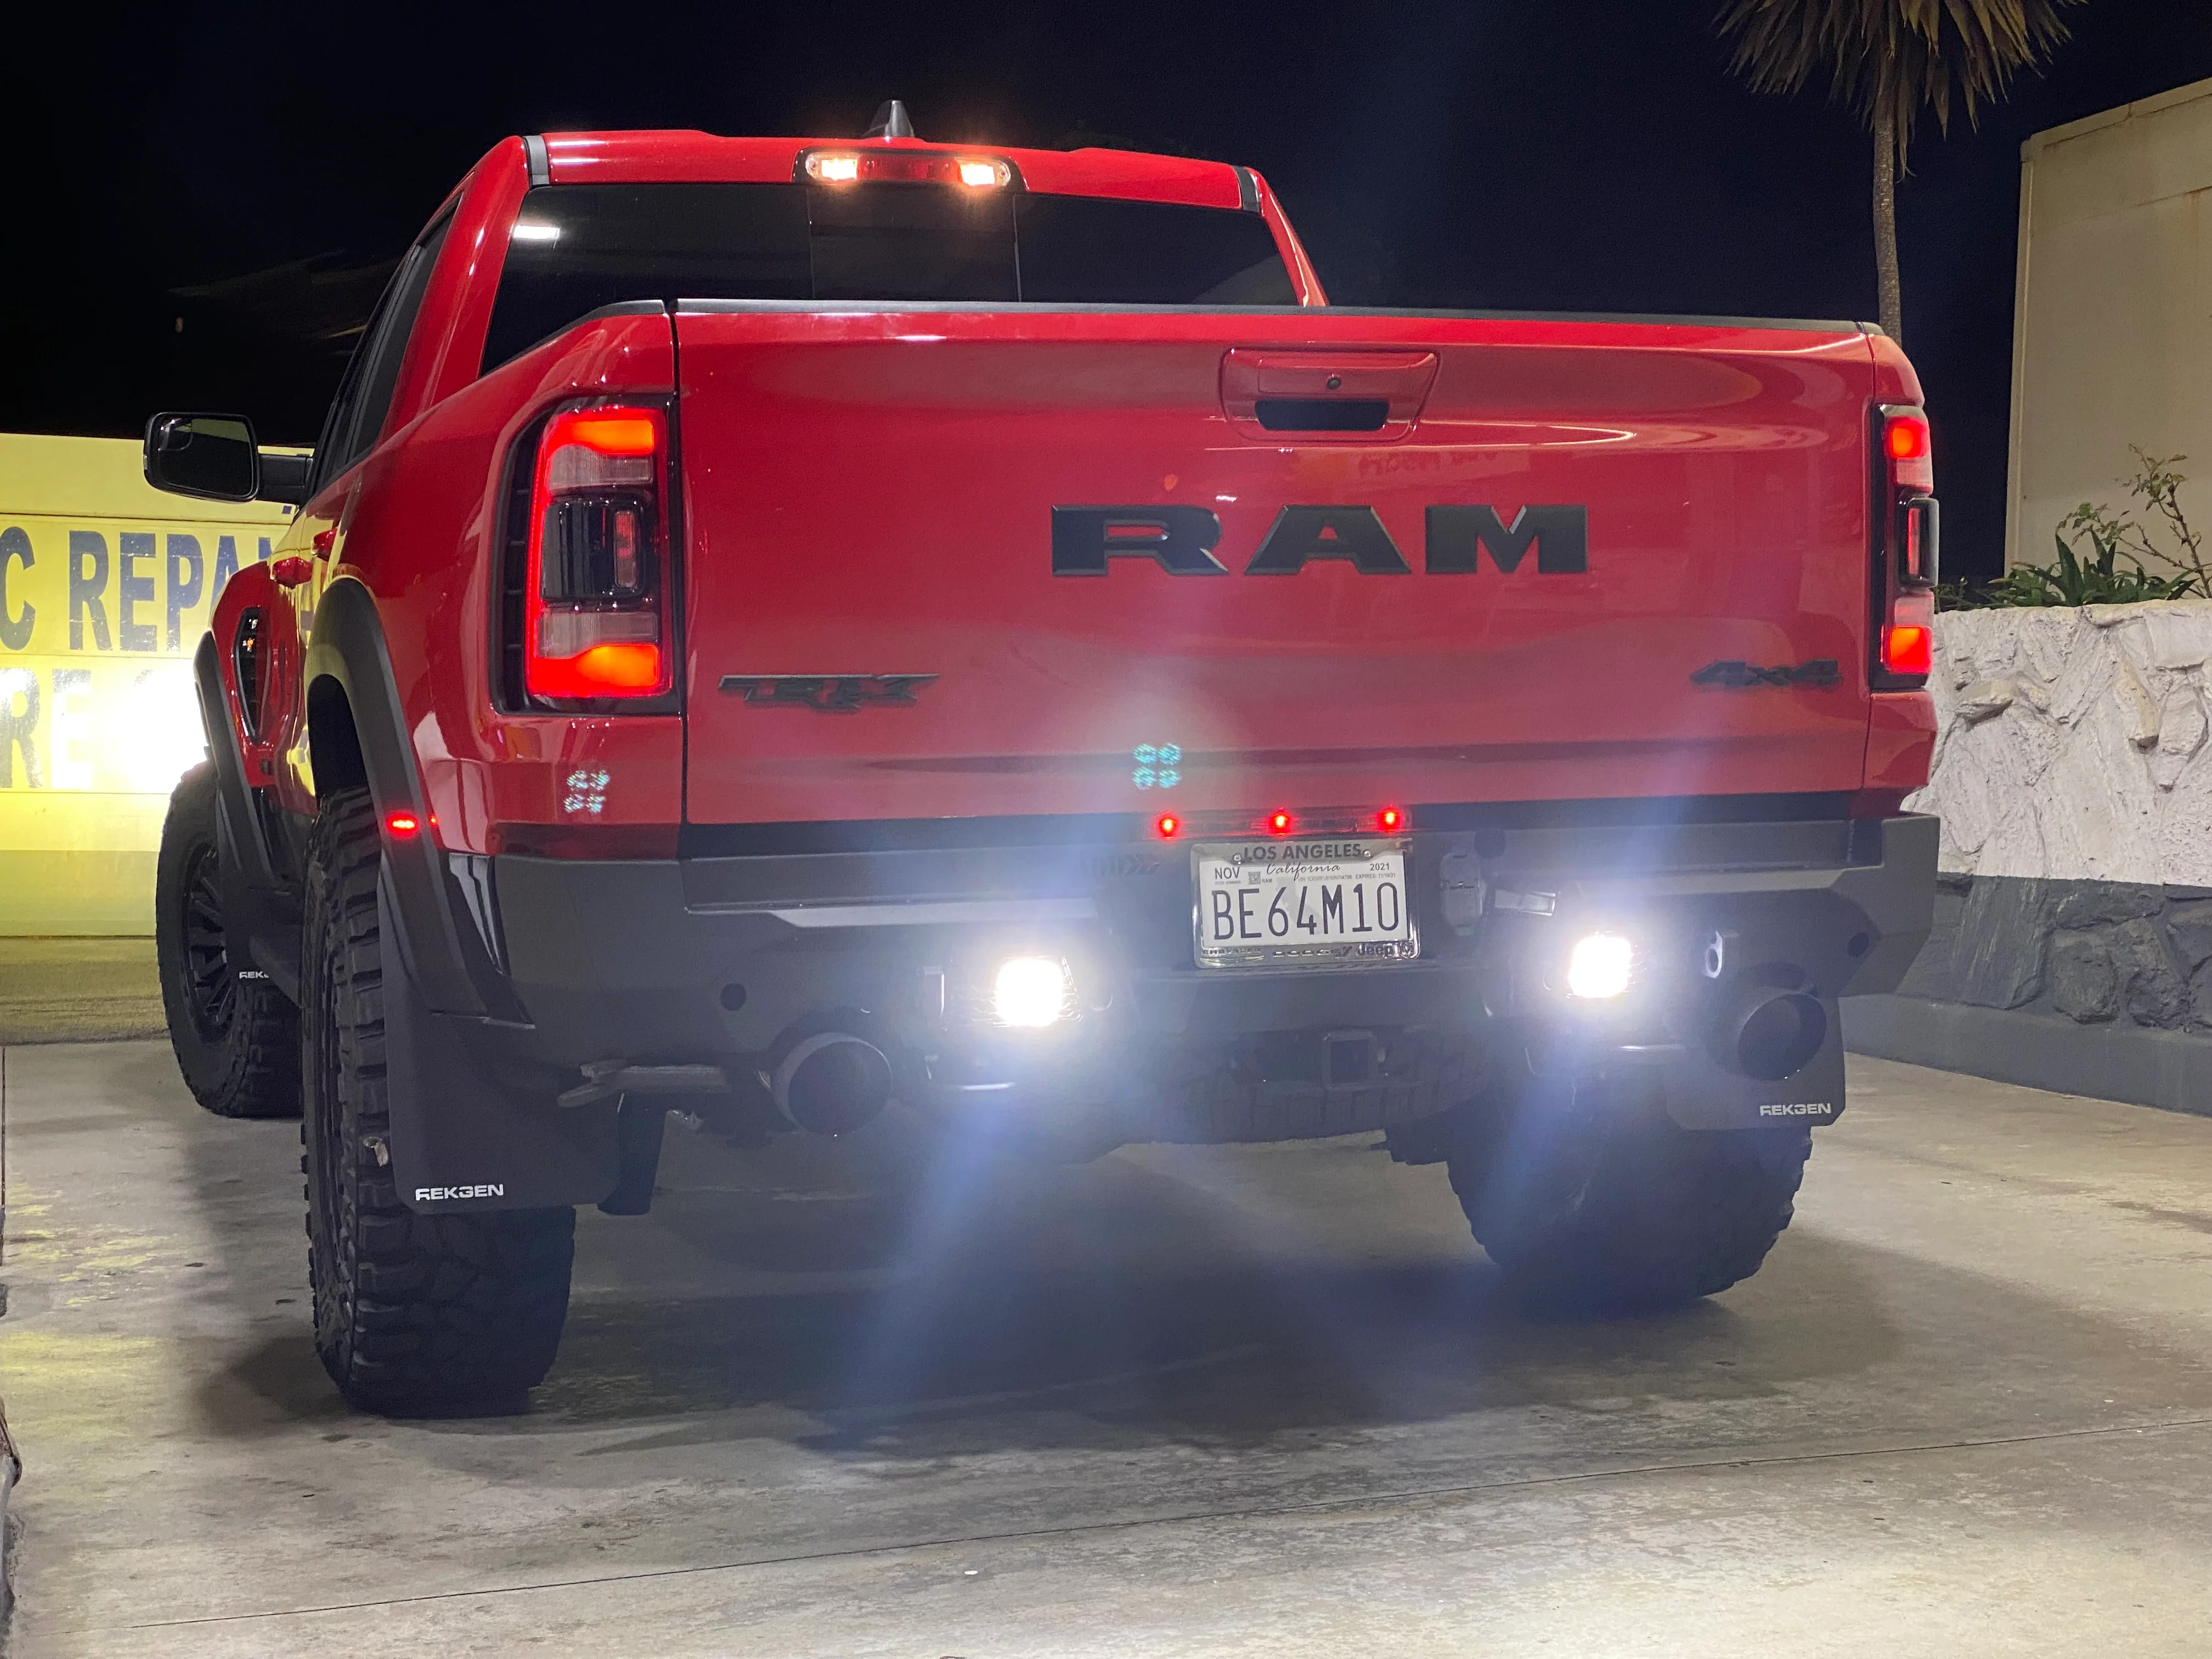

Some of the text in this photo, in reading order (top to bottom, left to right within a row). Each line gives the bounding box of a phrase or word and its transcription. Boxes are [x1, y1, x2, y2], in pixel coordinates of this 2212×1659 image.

[1052, 505, 1587, 576] RAM
[69, 530, 272, 652] REPA
[718, 673, 940, 709] TRX
[1243, 843, 1361, 862] LOS ANGELES
[1215, 867, 1240, 879] NOV
[1267, 862, 1341, 881] California
[1370, 862, 1390, 871] 2021
[1211, 882, 1399, 940] BE64M10
[1357, 942, 1399, 959] Jeep
